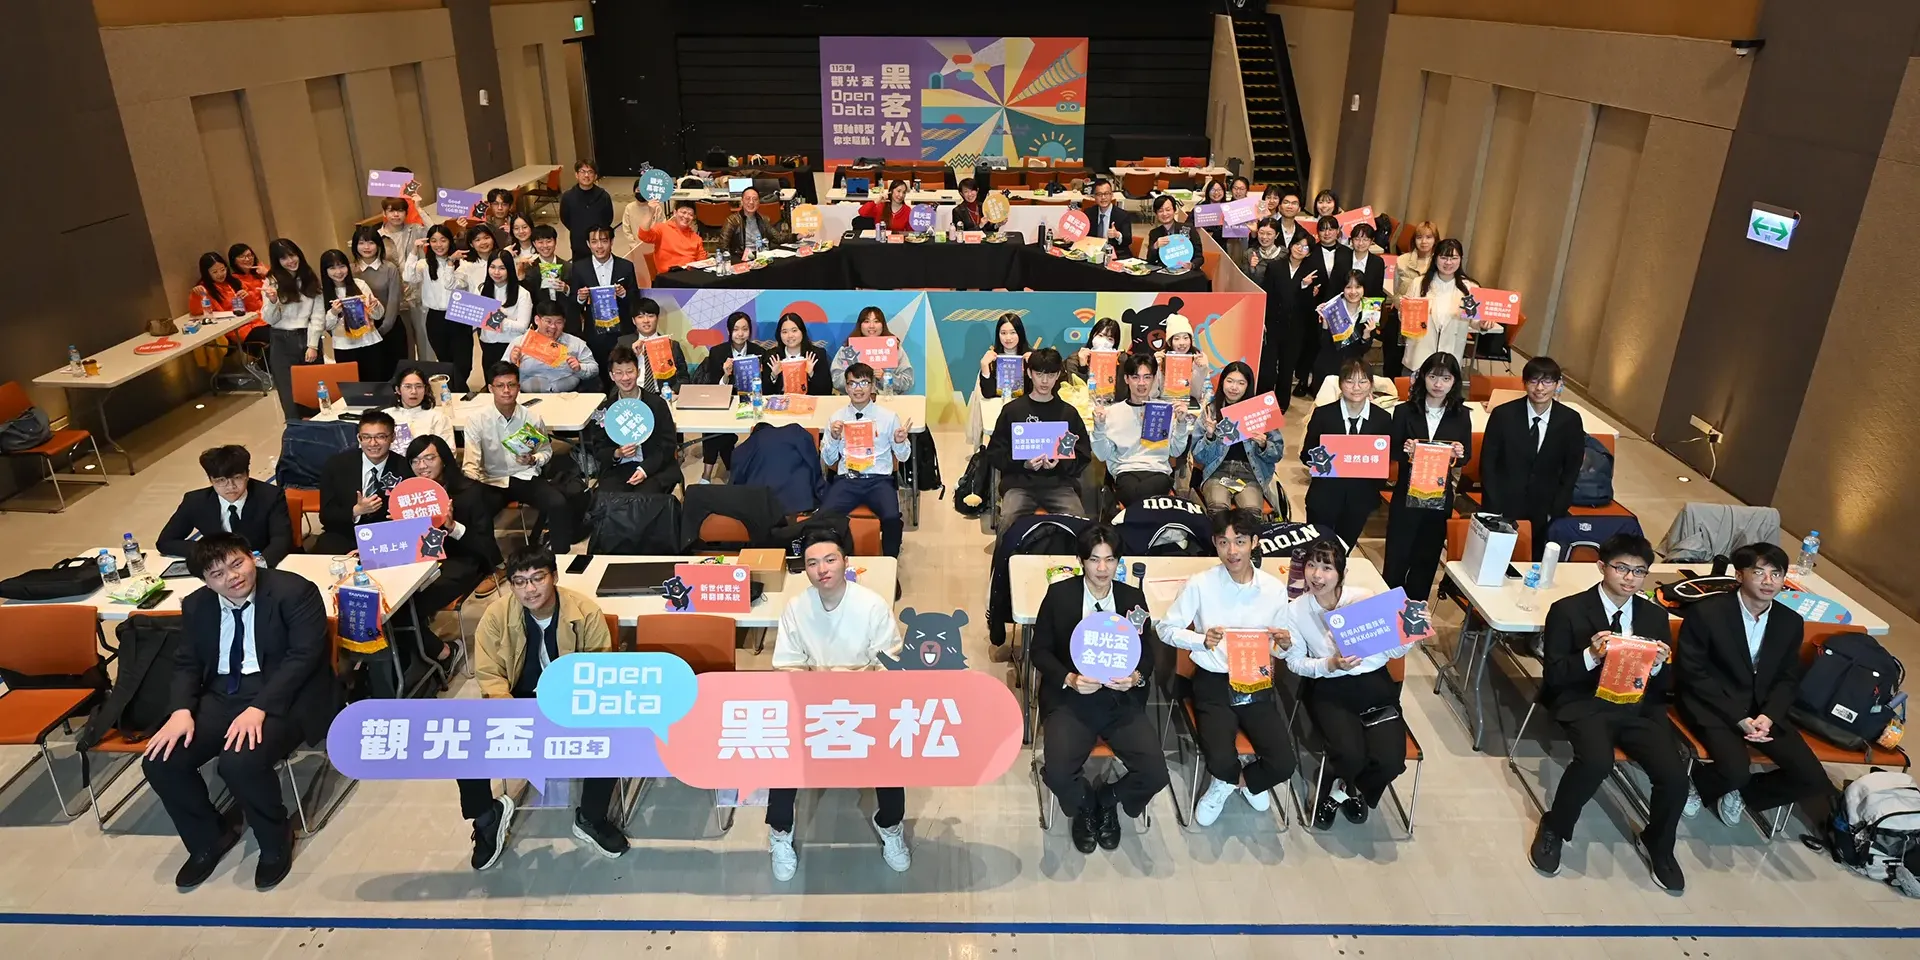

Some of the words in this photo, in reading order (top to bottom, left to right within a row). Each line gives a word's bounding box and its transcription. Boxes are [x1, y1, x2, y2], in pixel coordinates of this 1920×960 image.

[831, 65, 854, 73] 113年
[831, 76, 874, 87] 觀光盃
[832, 90, 874, 103] Open
[832, 104, 875, 116] Data
[880, 64, 912, 147] 黑客松
[833, 124, 875, 135] 雙軸轉型
[646, 184, 666, 193] 黑客松
[650, 177, 663, 185] 觀光
[913, 211, 932, 219] 觀光盃
[615, 408, 634, 425] 觀光
[619, 413, 644, 436] 黑客松
[631, 423, 648, 440] 大師
[1343, 454, 1380, 464] 遊然自得
[397, 489, 437, 508] 觀光盃
[1142, 497, 1204, 514] NTOU
[1259, 523, 1320, 554] NTOU
[369, 542, 408, 555] 十局上半
[700, 584, 741, 593] 新世代觀光
[700, 593, 741, 602] 用翻譯系統
[1084, 630, 1130, 650] 觀光盃
[1342, 626, 1391, 647] 改善KKday網站
[1082, 648, 1129, 669] 金勾盃
[573, 662, 663, 688] Open
[571, 690, 662, 715] Data
[717, 697, 962, 759] 黑客松
[359, 717, 535, 761] 觀光盃
[550, 739, 605, 756] 113年
